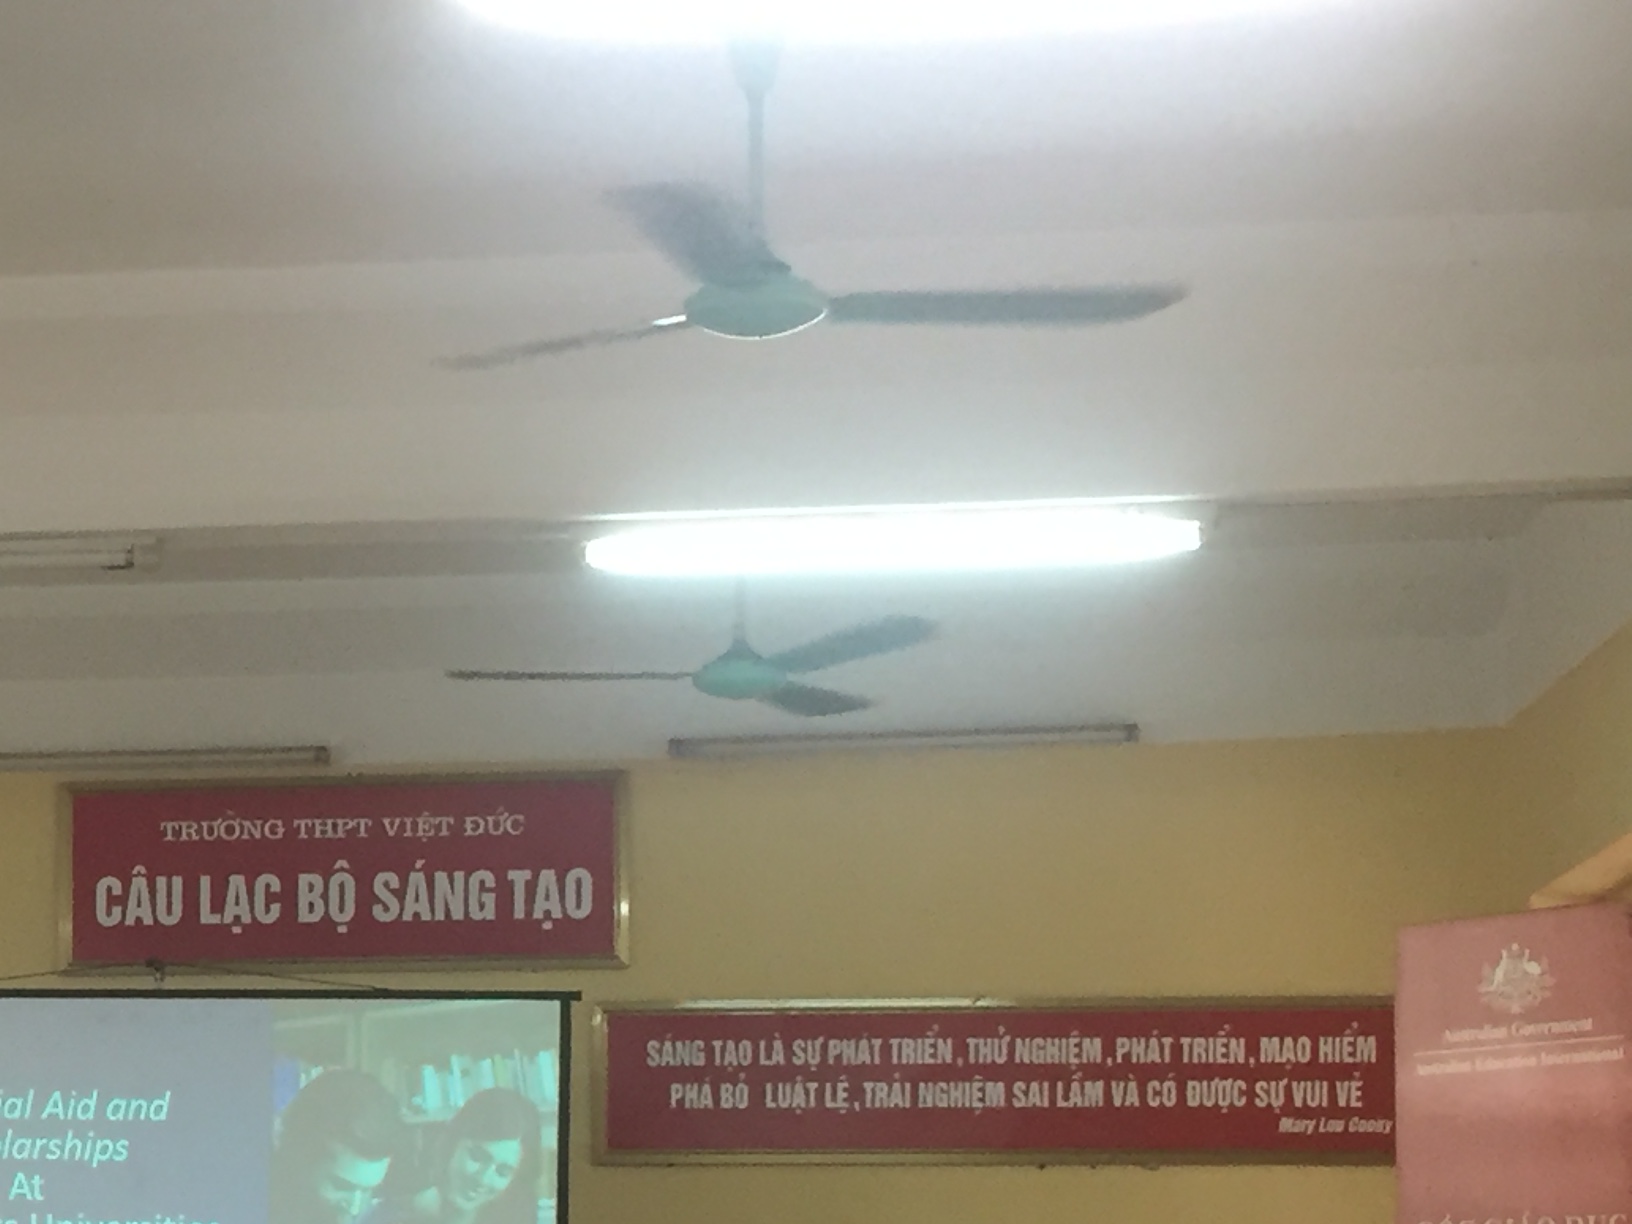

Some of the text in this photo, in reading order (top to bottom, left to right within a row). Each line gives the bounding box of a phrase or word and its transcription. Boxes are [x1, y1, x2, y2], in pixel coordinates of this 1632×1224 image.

[161, 807, 526, 842] TRƯỜNG THPT VIỆT ĐỨC
[95, 859, 594, 934] CÂU LẠC BỘ SÁNG TẠO
[647, 1032, 706, 1067] SÁNG
[712, 1038, 753, 1072] TẠO
[759, 1032, 785, 1066] LÀ
[791, 1035, 825, 1071] SỰ
[828, 1032, 883, 1066] PHÁT
[966, 1024, 1011, 1065] THỬ
[1115, 1029, 1174, 1064] PHÁT
[1259, 1035, 1311, 1069] MẠO
[1318, 1021, 1377, 1064] HIỂM
[41, 1089, 97, 1120] Aid
[106, 1090, 171, 1122] and
[670, 1077, 714, 1109] PHÁ
[720, 1072, 749, 1109] BỎ
[765, 1075, 818, 1114] LUẬT
[863, 1072, 911, 1108] TRẢI
[918, 1074, 1006, 1115] NGHIỆM
[1012, 1080, 1050, 1108] SAI
[1111, 1074, 1140, 1108] VÀ
[1147, 1073, 1178, 1108] CÓ
[1186, 1077, 1248, 1113] ĐƯỢC
[1254, 1078, 1289, 1113] SỰ
[1292, 1080, 1329, 1108] VUI
[1335, 1071, 1364, 1108] VẺ
[9, 1172, 45, 1201] At
